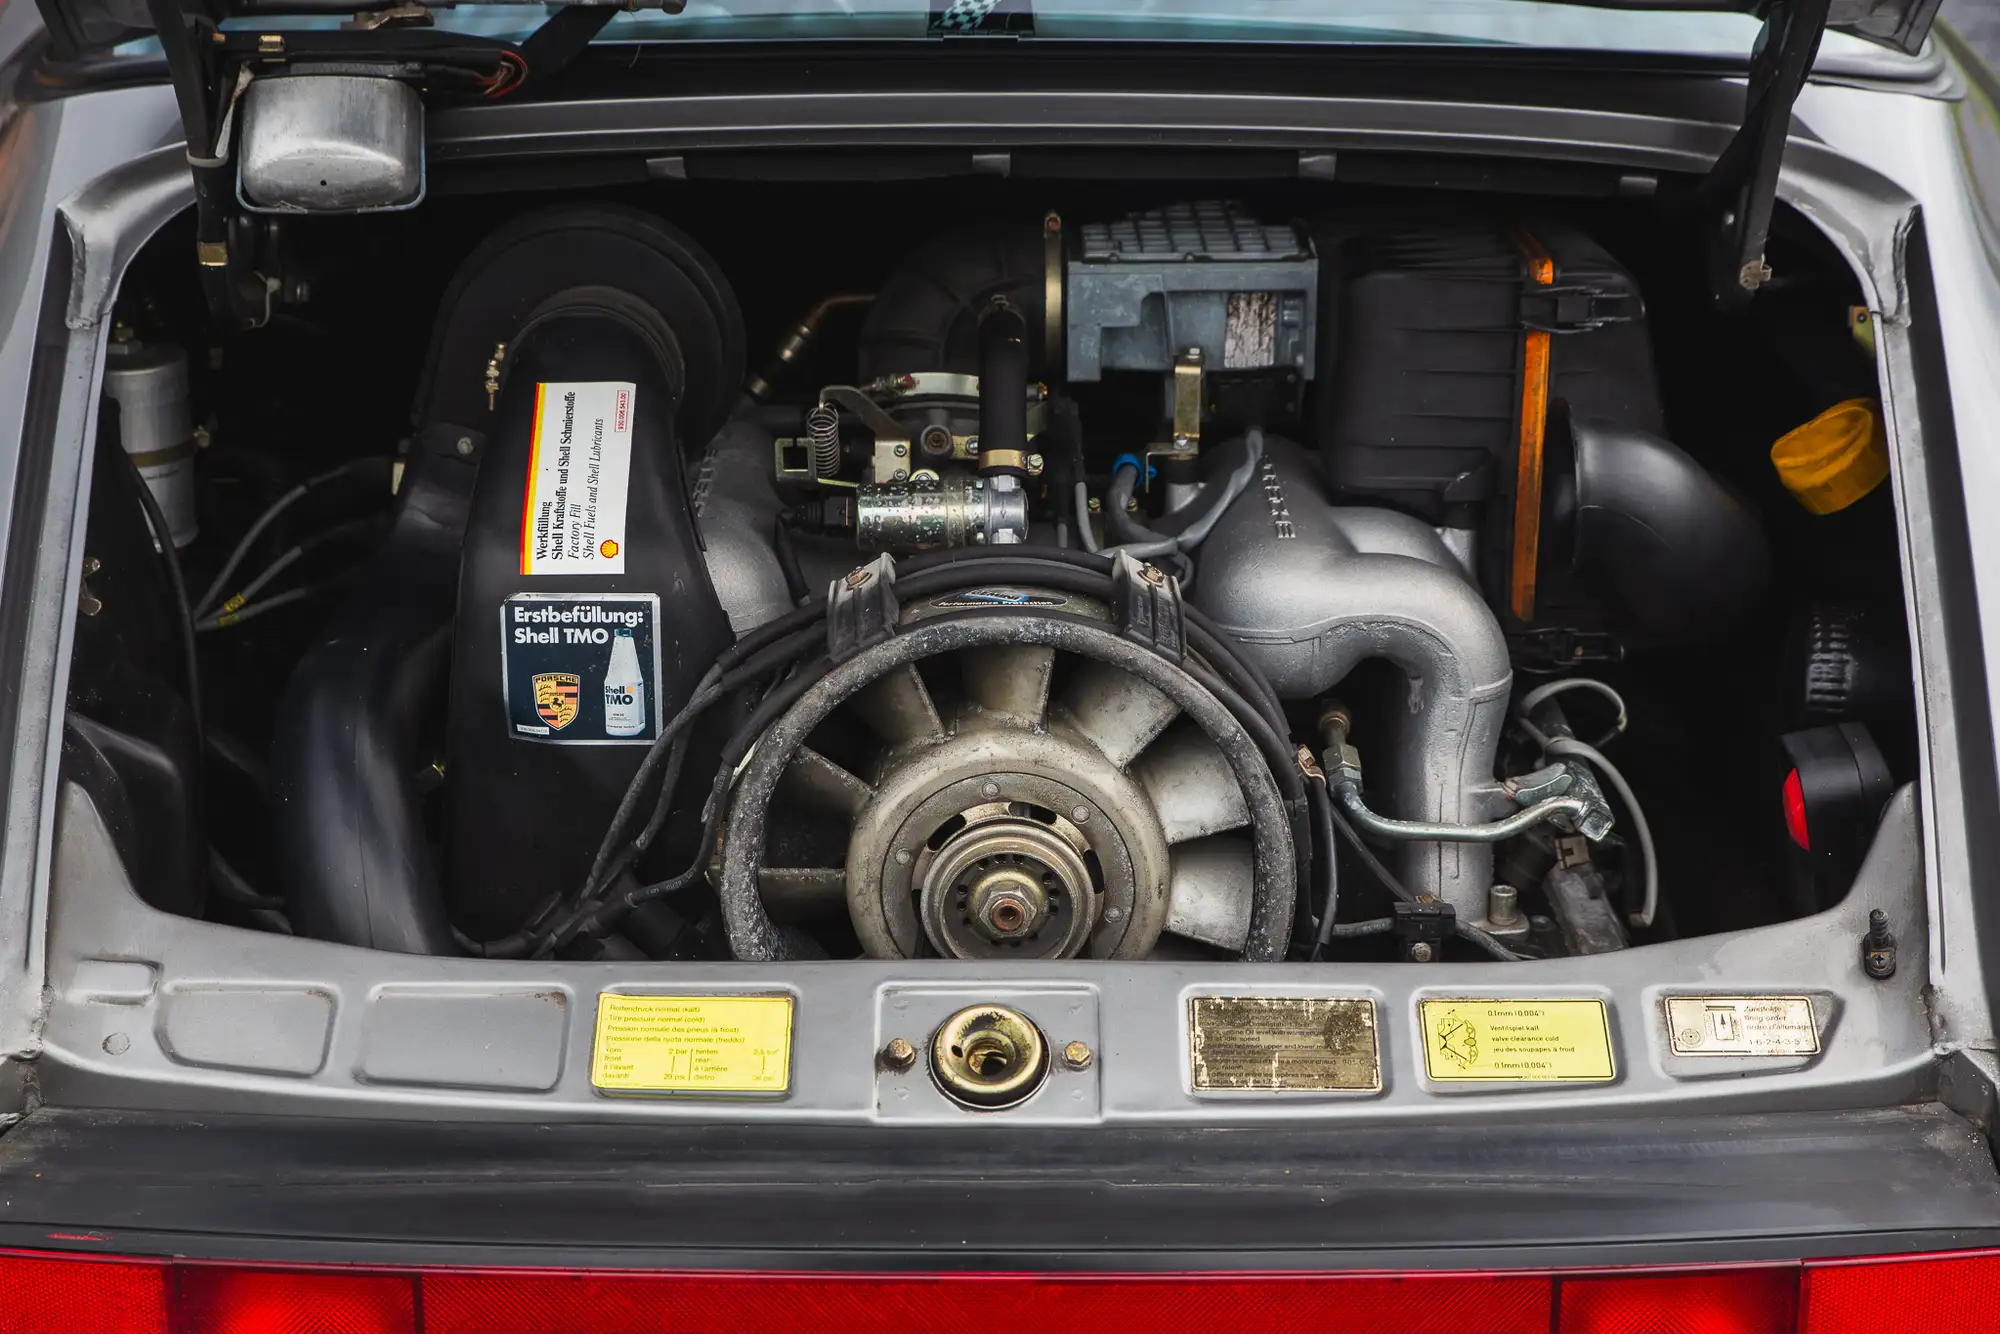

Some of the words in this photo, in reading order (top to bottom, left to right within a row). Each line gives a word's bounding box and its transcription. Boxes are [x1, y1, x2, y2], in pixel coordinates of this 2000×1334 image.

[561, 392, 576, 444] Schmierstoffe
[589, 418, 604, 461] Lubricants
[559, 447, 571, 466] Shell
[558, 469, 568, 484] und
[588, 464, 600, 485] Shell
[588, 487, 598, 503] and
[552, 487, 567, 530] Kraftstoffe
[570, 504, 581, 518] Fill
[584, 505, 597, 530] Fuels
[536, 501, 552, 560] Werkfüllung
[568, 521, 582, 559] Factory
[552, 533, 563, 559] Shell
[583, 532, 594, 559] Shell
[514, 605, 644, 628] Erstbefüllung:
[514, 628, 559, 644] Shell
[564, 628, 609, 644] TMO
[535, 675, 576, 683] PORSCHE
[605, 685, 625, 694] Shell
[606, 694, 633, 705] TMO
